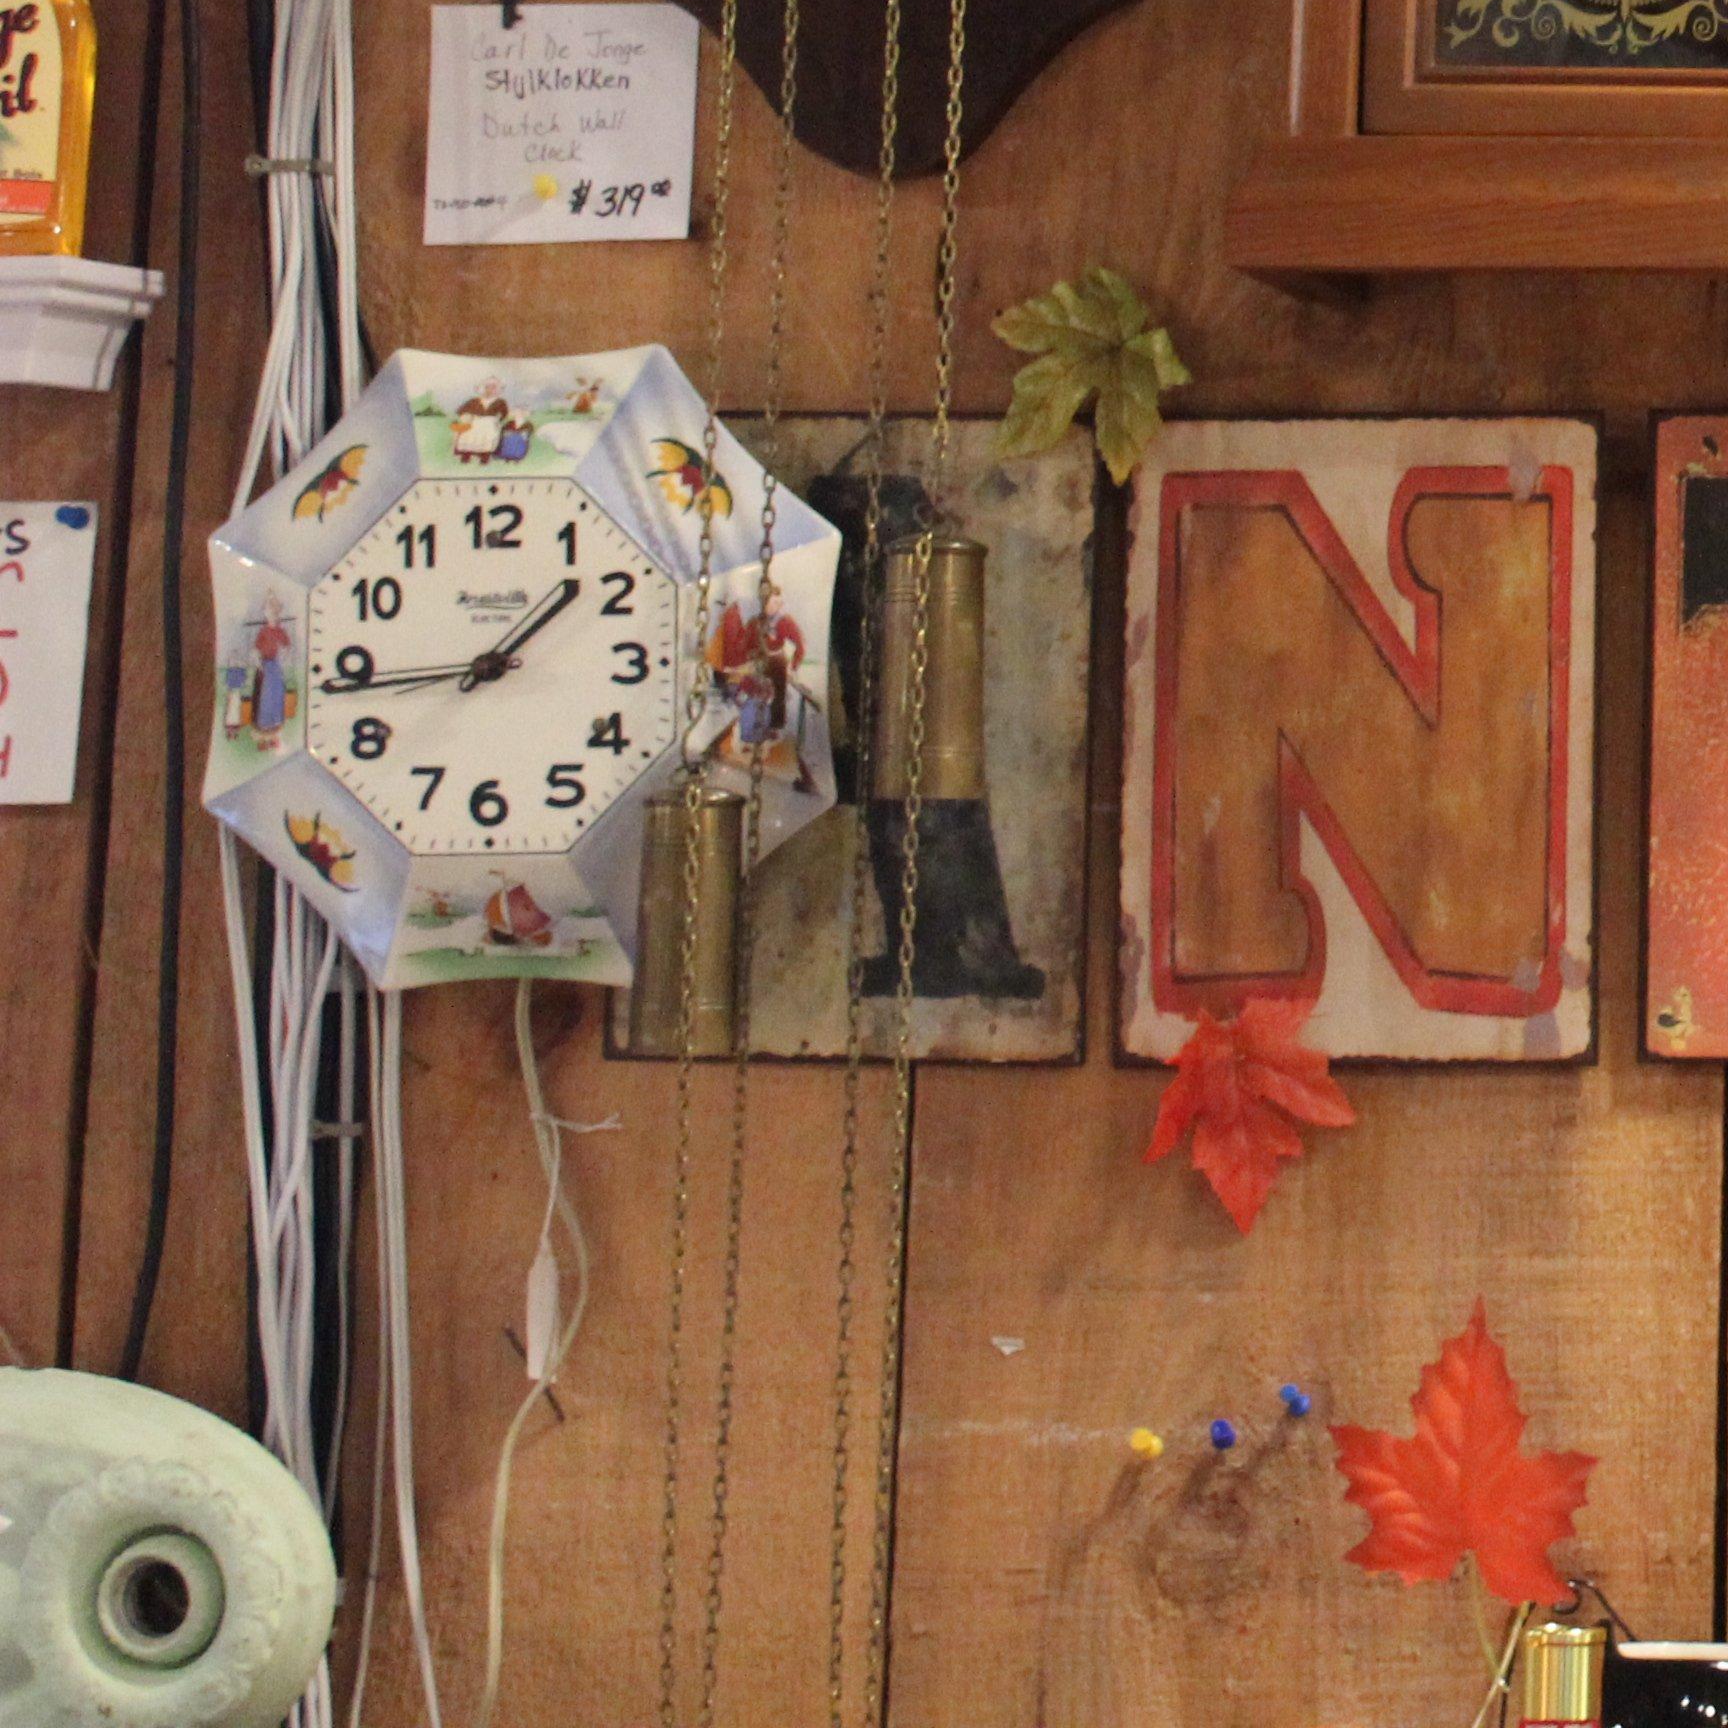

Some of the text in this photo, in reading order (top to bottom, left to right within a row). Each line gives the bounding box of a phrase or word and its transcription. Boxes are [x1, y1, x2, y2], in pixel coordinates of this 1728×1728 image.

[396, 526, 436, 567] 11
[465, 504, 522, 548] 12
[558, 524, 576, 565] 1
[352, 578, 401, 620] 10
[600, 572, 635, 614] 2
[611, 642, 649, 684] 3
[351, 718, 390, 758] 8
[588, 713, 629, 754] 4
[411, 767, 445, 810] 7
[470, 781, 508, 825] 6
[546, 765, 585, 808] 5
